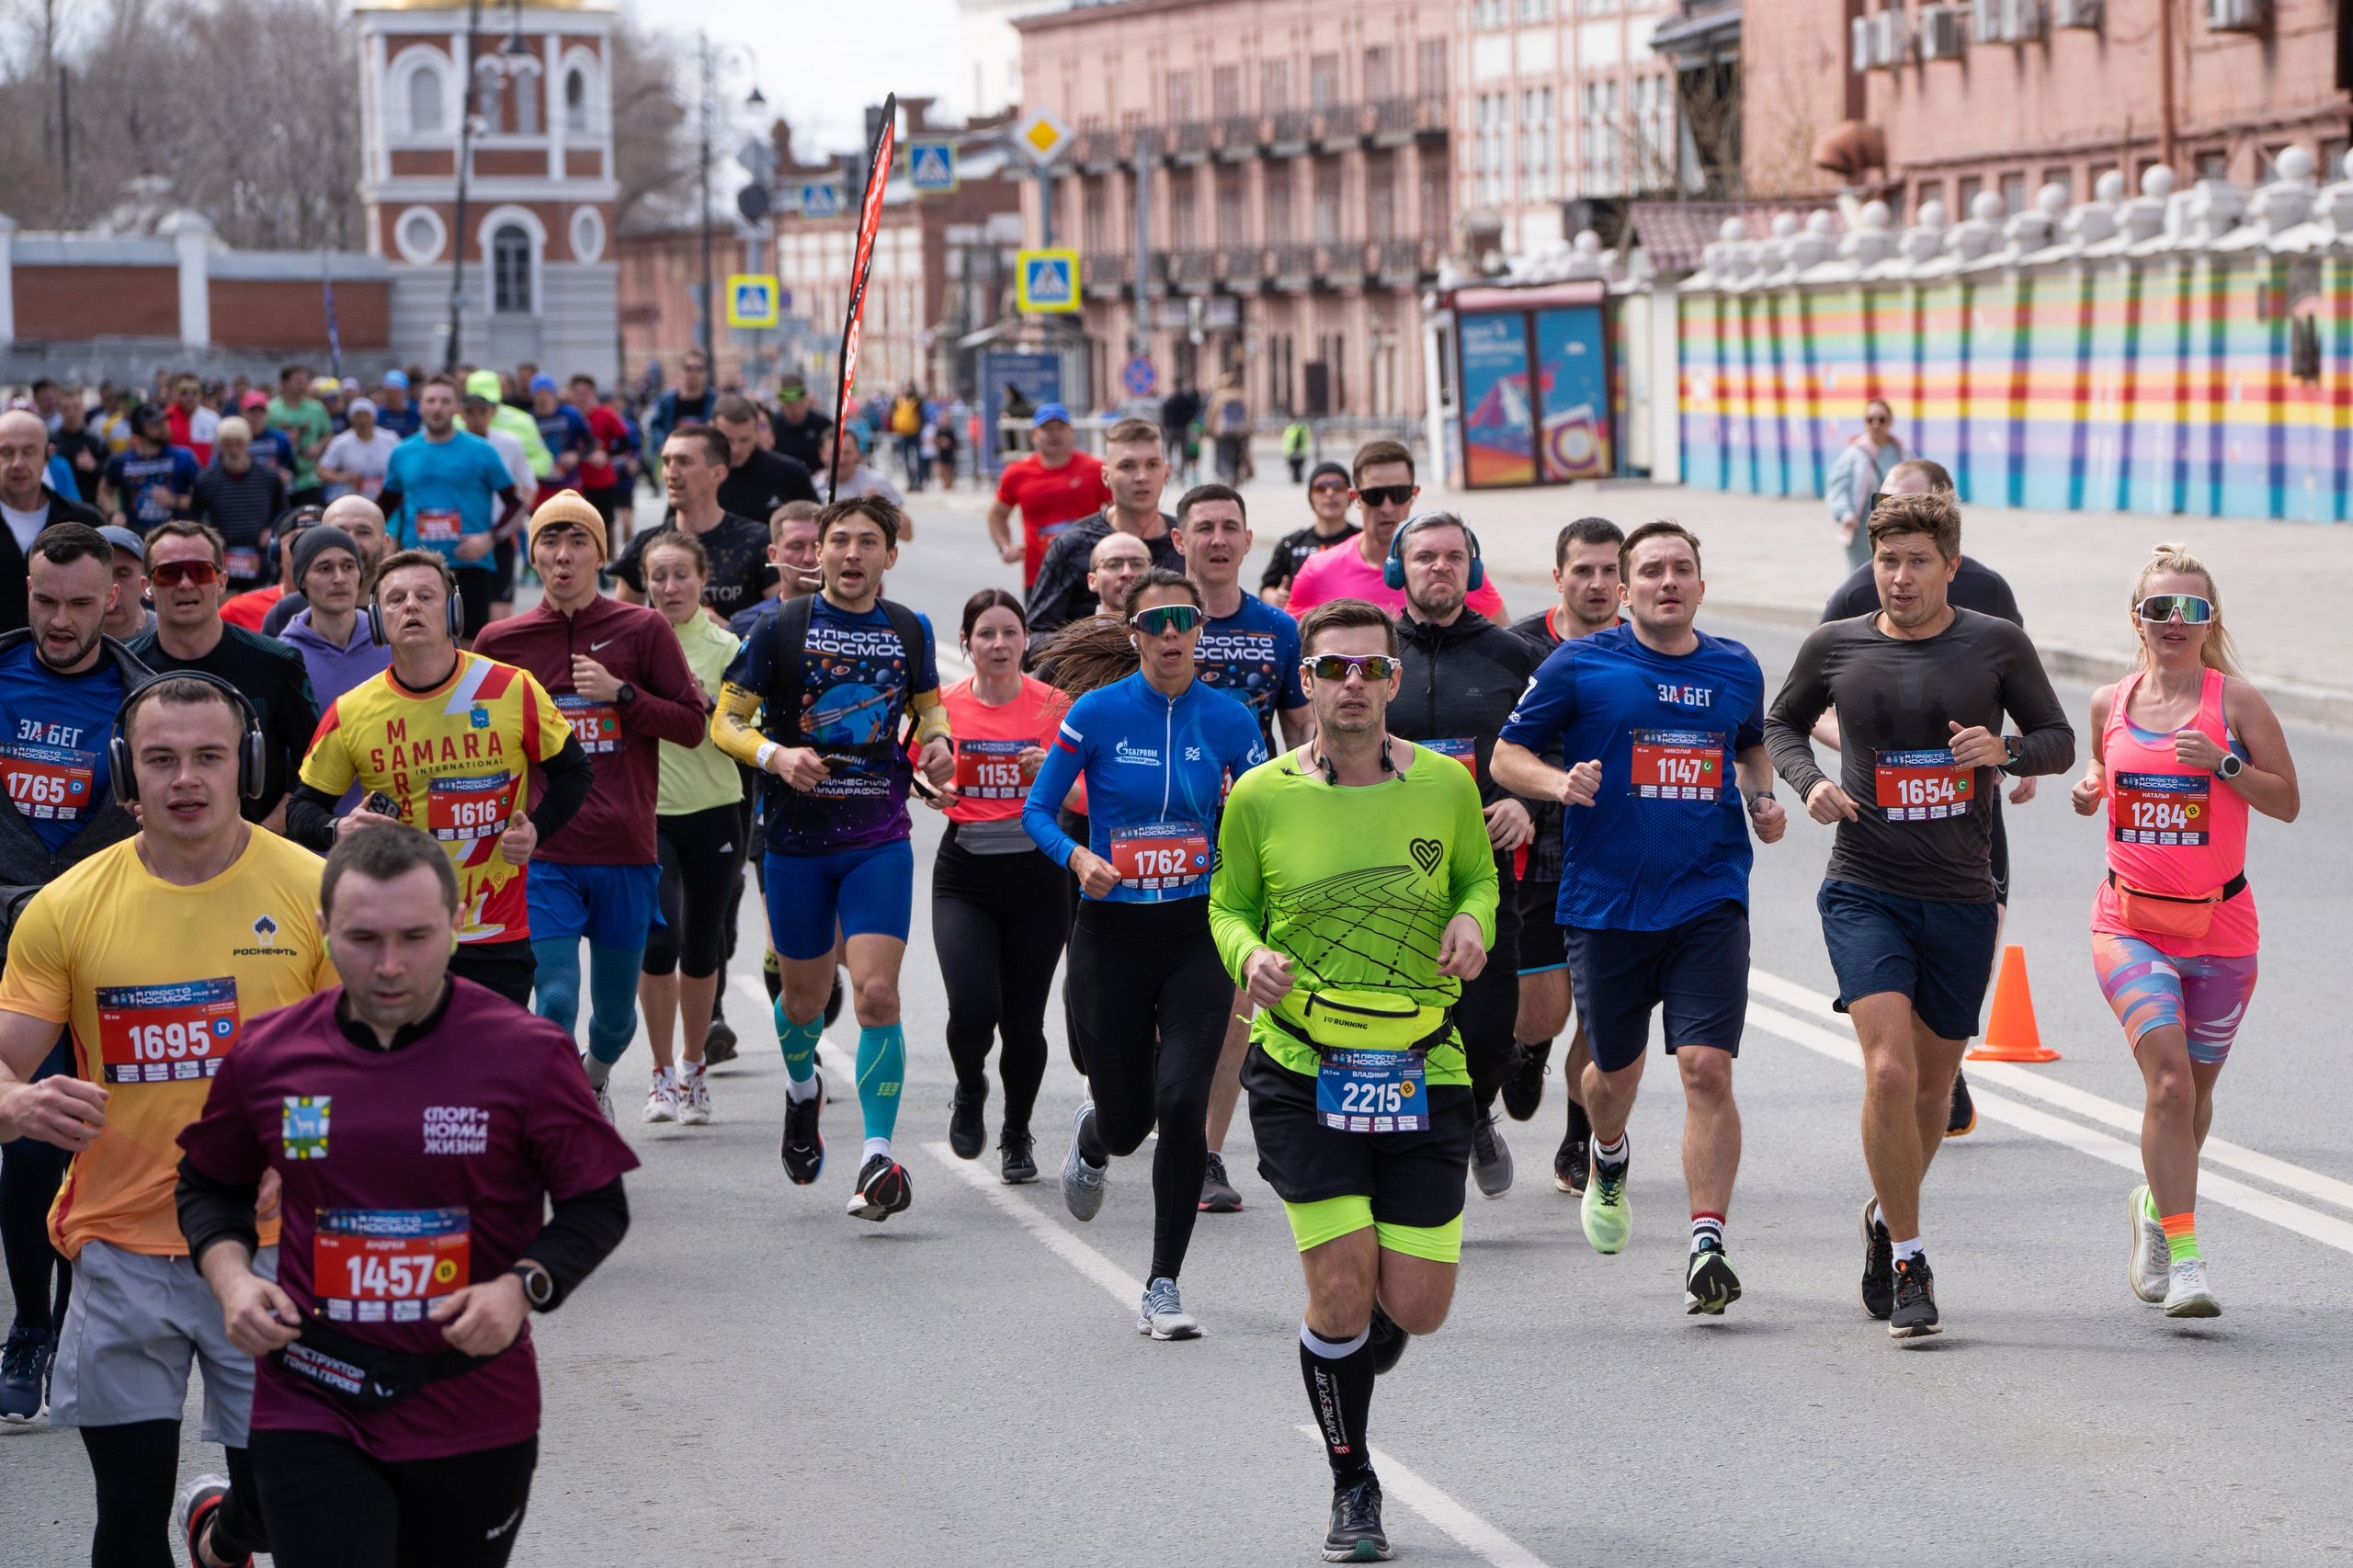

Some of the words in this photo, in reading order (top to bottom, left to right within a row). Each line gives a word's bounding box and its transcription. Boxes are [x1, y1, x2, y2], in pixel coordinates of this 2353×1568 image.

[1194, 647, 1276, 661] ОСМОС
[370, 732, 503, 773] SAMARA
[1129, 748, 1157, 757] GAZPROM
[415, 758, 504, 776] INTERNATIONAL
[977, 764, 1020, 786] 1153
[1657, 758, 1701, 784] 1147
[7, 772, 65, 803] 1765
[73, 783, 81, 791] D
[1898, 778, 1956, 805] 1654
[451, 800, 496, 825] 1616
[2132, 801, 2188, 829] 1284
[2188, 807, 2197, 815] B
[1134, 848, 1187, 875] 1762
[233, 948, 297, 956] РОСНЕФТЬ
[136, 994, 192, 1005] КОСМОС
[144, 987, 191, 996] ПРОСТО
[1335, 1018, 1368, 1029] RUNNING
[129, 1020, 210, 1061] 1695
[218, 1021, 230, 1033] D
[1342, 1083, 1401, 1113] 2215
[1403, 1085, 1412, 1094] B
[424, 1107, 476, 1122] СПОРТ
[423, 1123, 487, 1138] НОРМА
[424, 1139, 486, 1154] ЖИЗНИ
[347, 1256, 435, 1296] 1457
